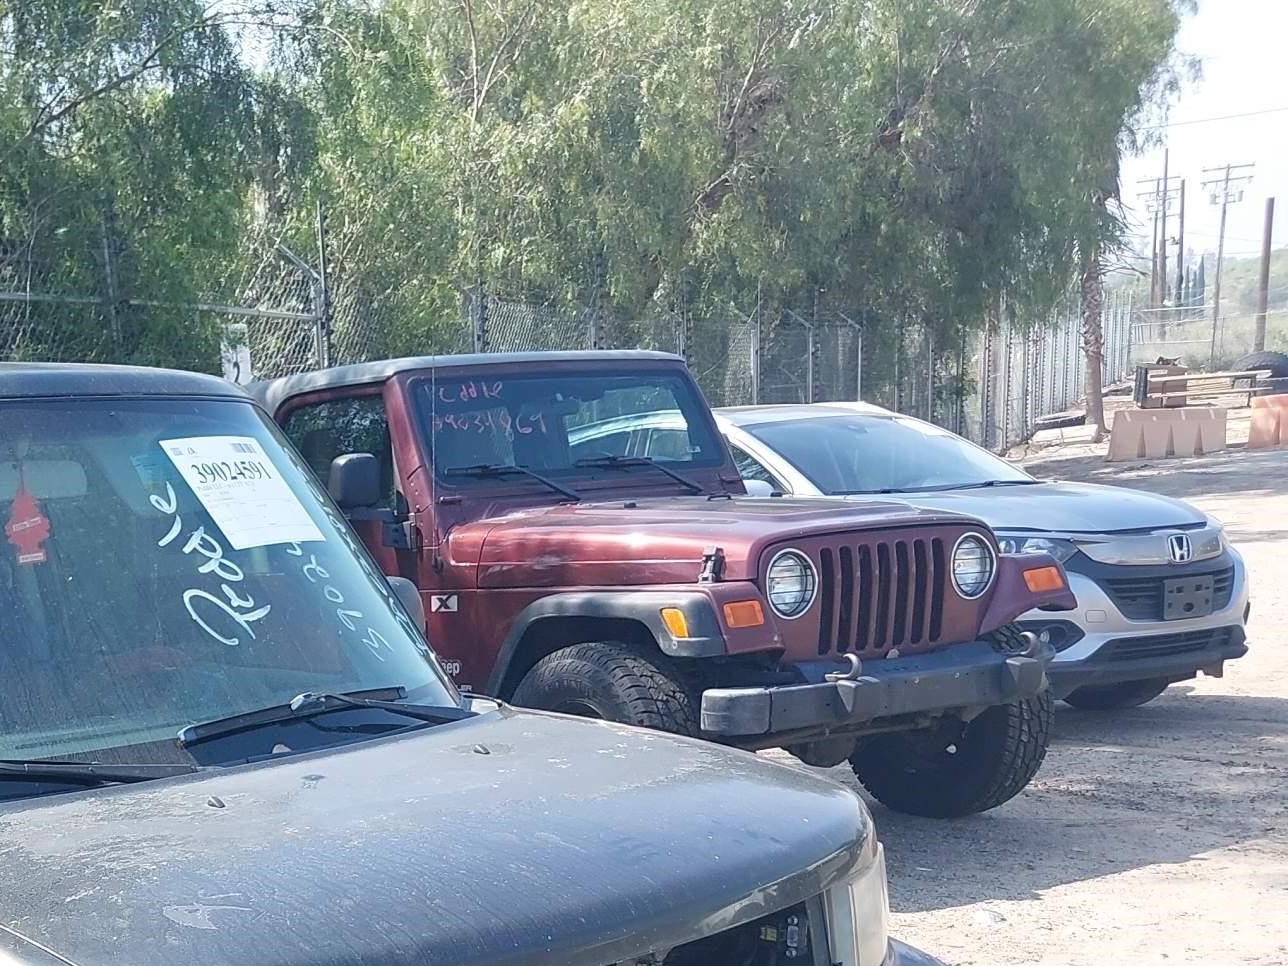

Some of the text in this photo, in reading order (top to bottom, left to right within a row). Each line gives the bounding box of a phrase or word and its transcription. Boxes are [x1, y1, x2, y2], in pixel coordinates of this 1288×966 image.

[191, 460, 272, 484] 39024591
[149, 480, 272, 647] Peddle
[286, 541, 394, 663] 39024
[442, 662, 460, 677] ep
